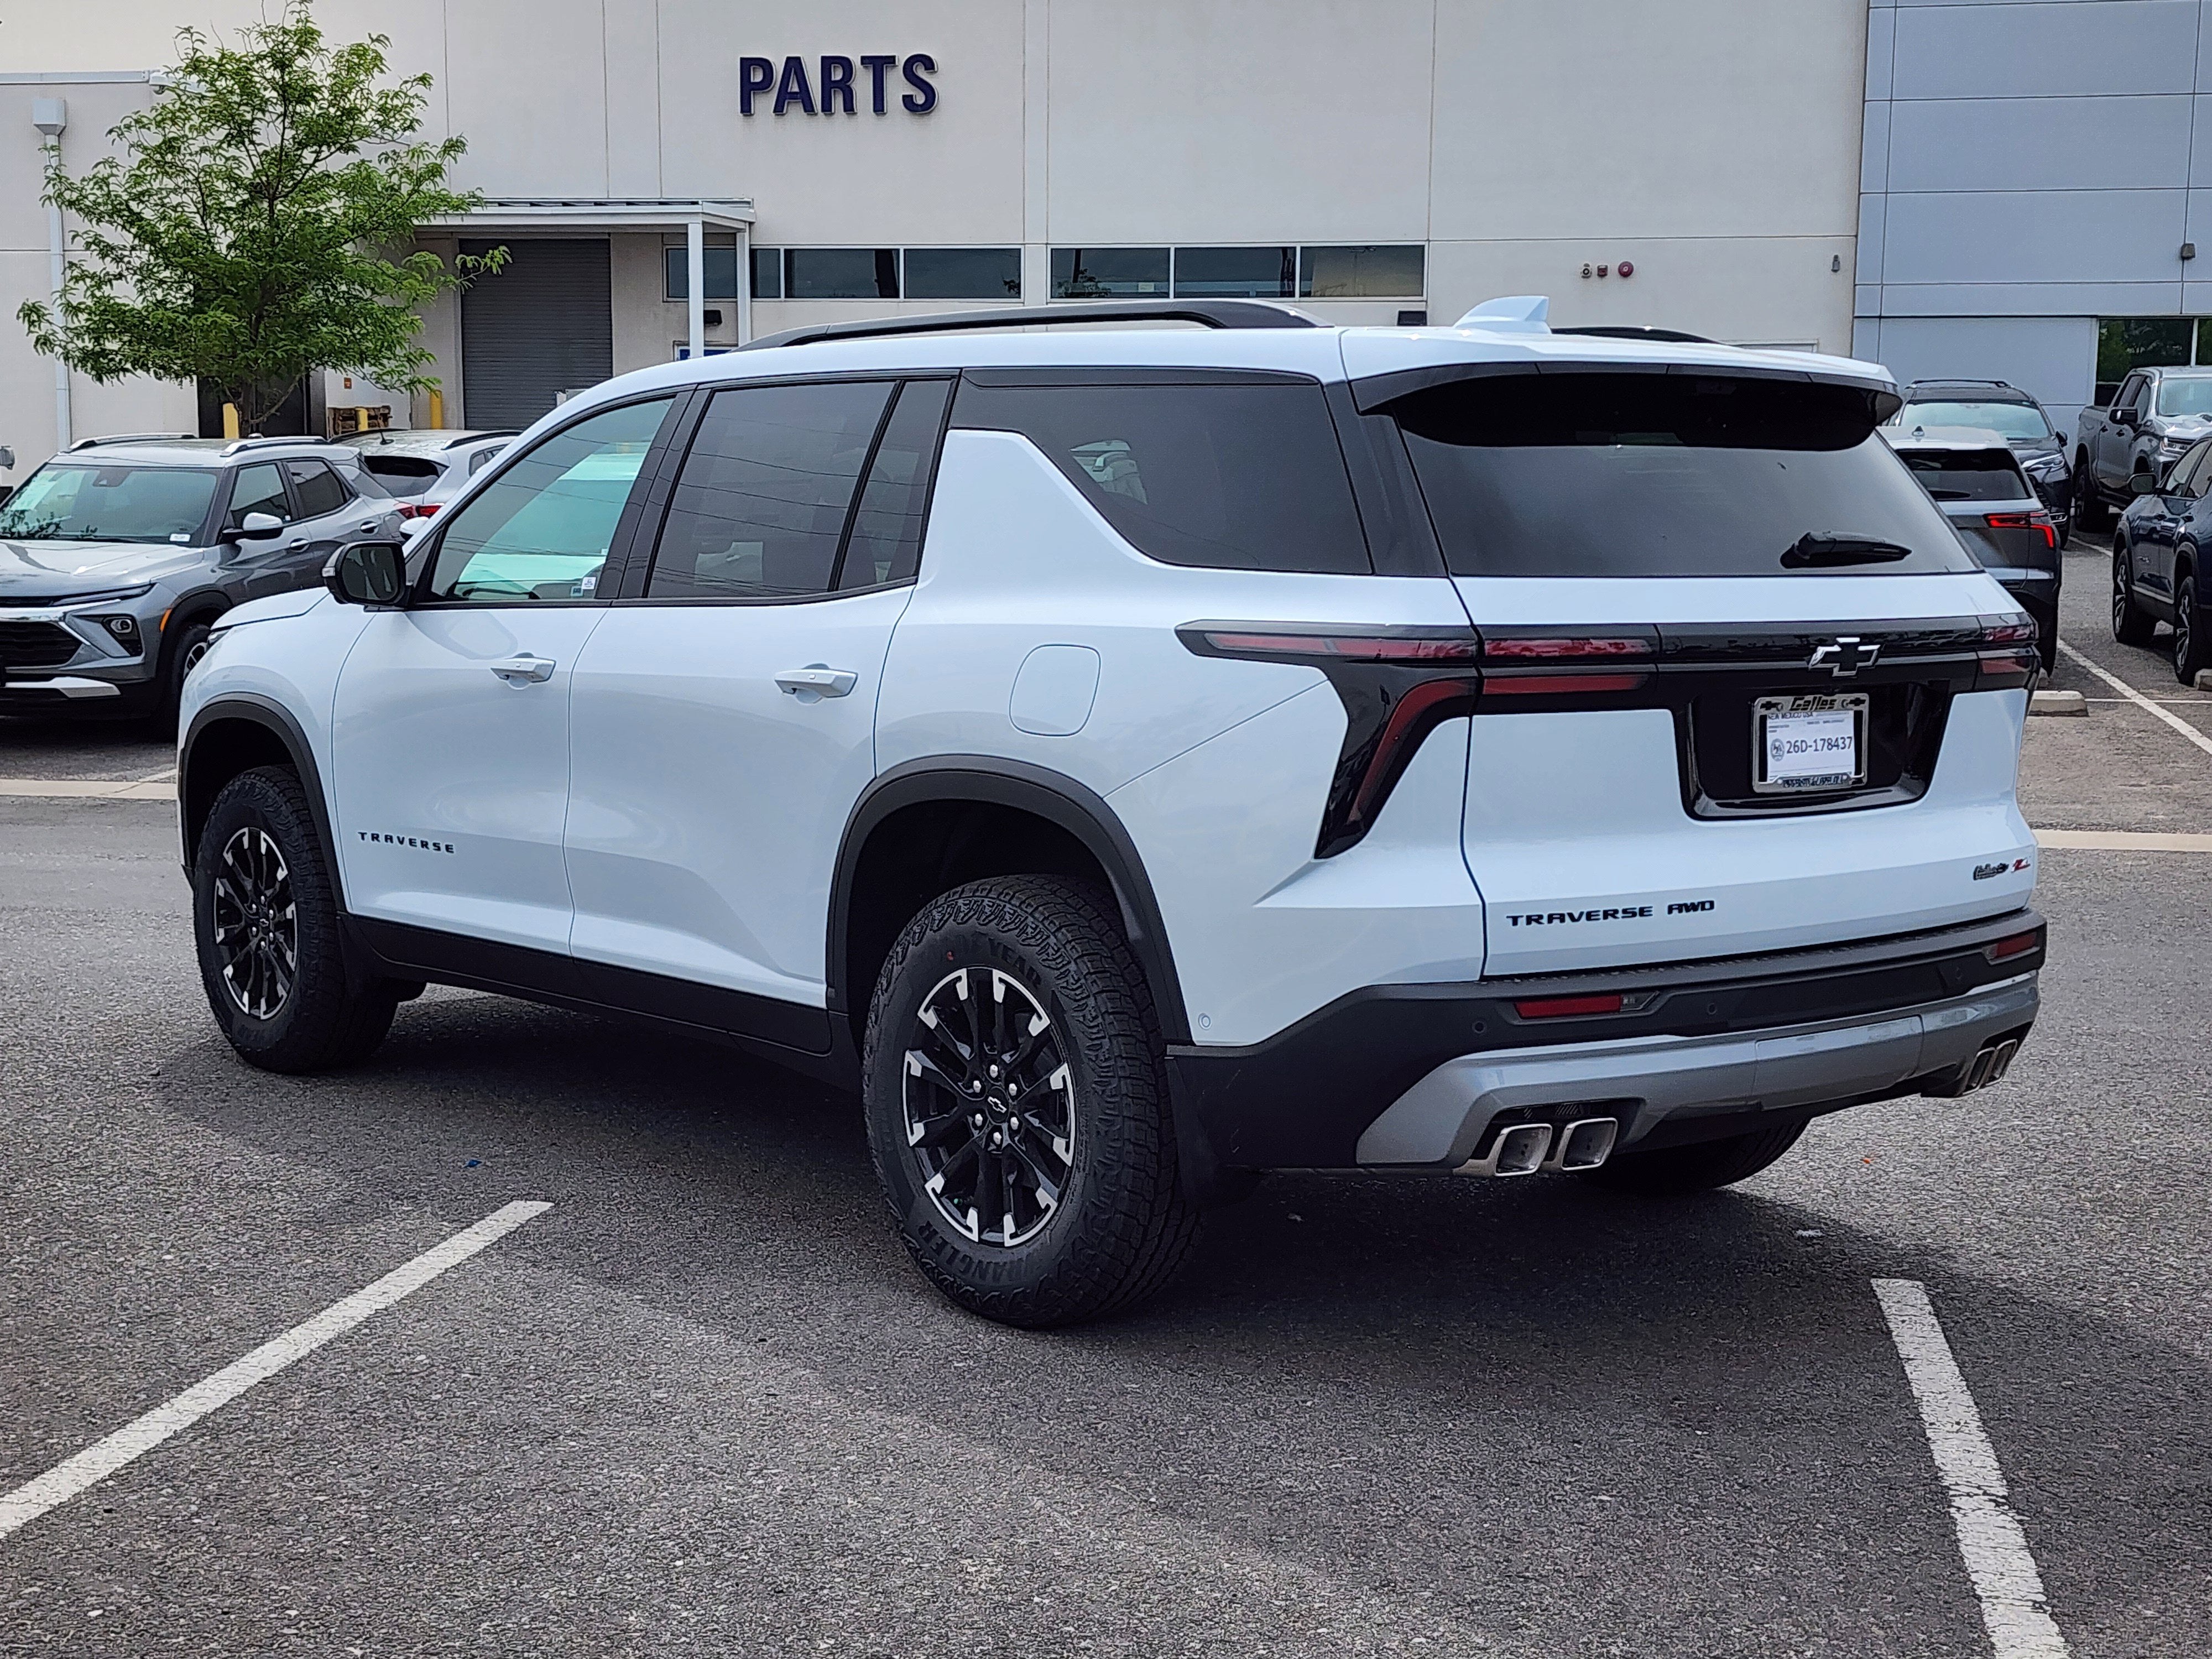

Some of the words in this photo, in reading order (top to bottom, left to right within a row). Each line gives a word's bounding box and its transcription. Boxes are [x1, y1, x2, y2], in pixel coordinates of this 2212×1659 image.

[739, 53, 938, 115] PARTS
[1786, 736, 1853, 754] 26D-178437
[357, 831, 455, 854] TRAVERSE
[1506, 905, 1653, 927] TRAVERSE
[1667, 900, 1715, 915] AWD
